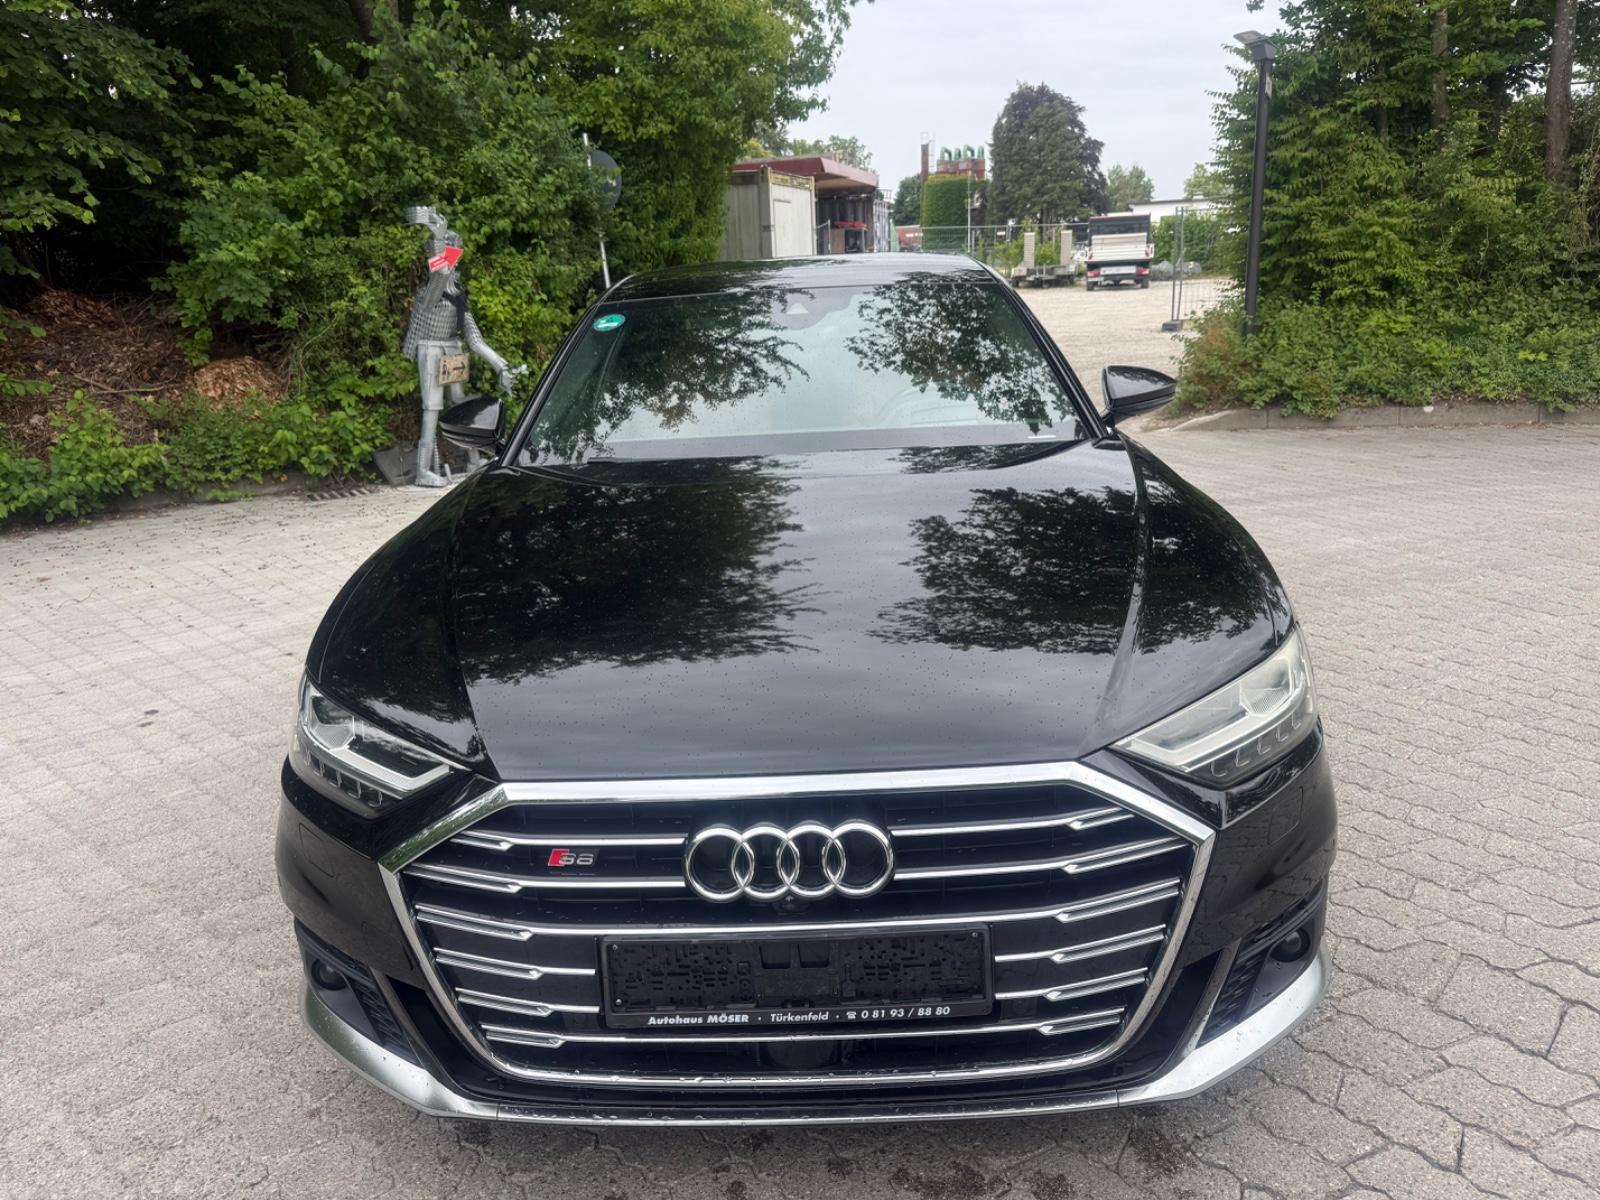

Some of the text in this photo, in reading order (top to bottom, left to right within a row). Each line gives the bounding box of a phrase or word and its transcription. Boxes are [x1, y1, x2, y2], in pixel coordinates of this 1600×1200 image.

[648, 1015, 703, 1025] Autohaus
[707, 1012, 749, 1024] MÖSER
[770, 1011, 829, 1022] Türkenfeld
